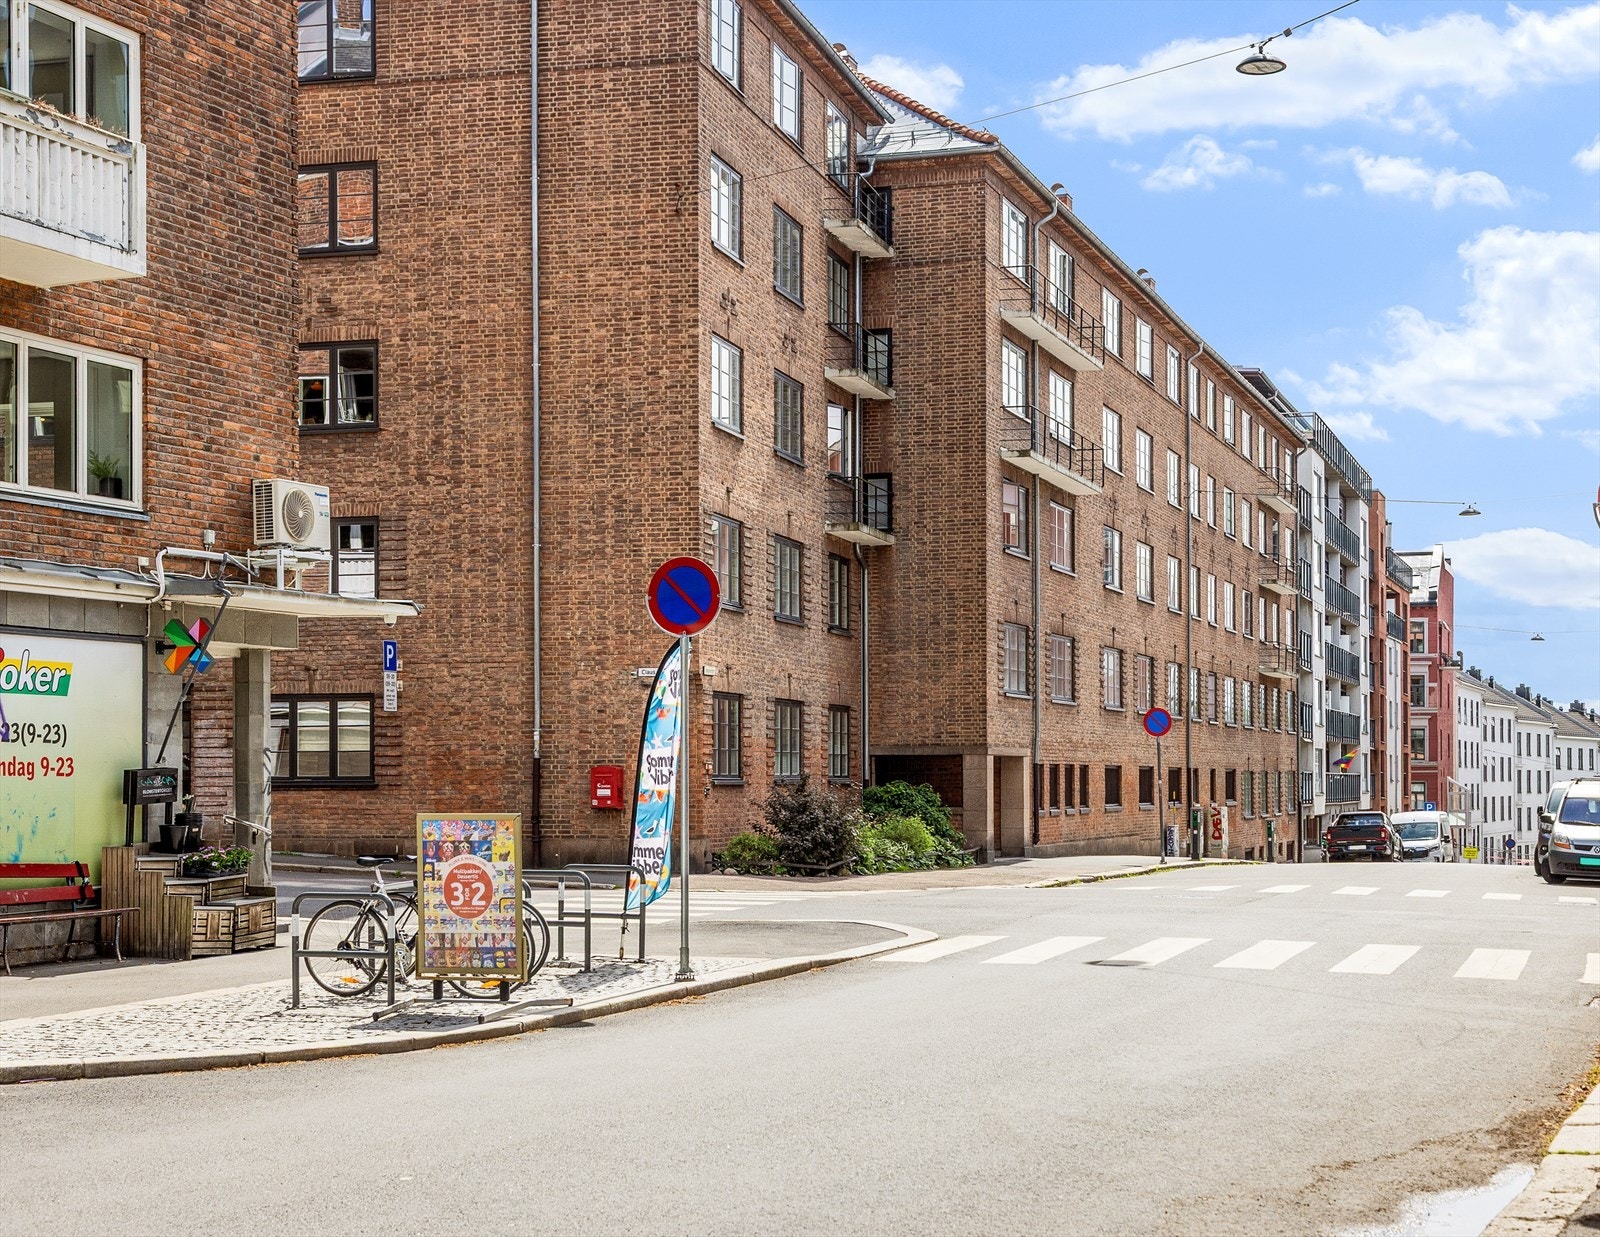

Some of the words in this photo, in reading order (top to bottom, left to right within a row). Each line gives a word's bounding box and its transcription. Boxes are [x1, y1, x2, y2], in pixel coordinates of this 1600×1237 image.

[386, 644, 394, 668] P
[0, 647, 68, 693] oker
[40, 756, 75, 777] 9-23
[450, 881, 465, 906] 3
[471, 881, 486, 906] 2
